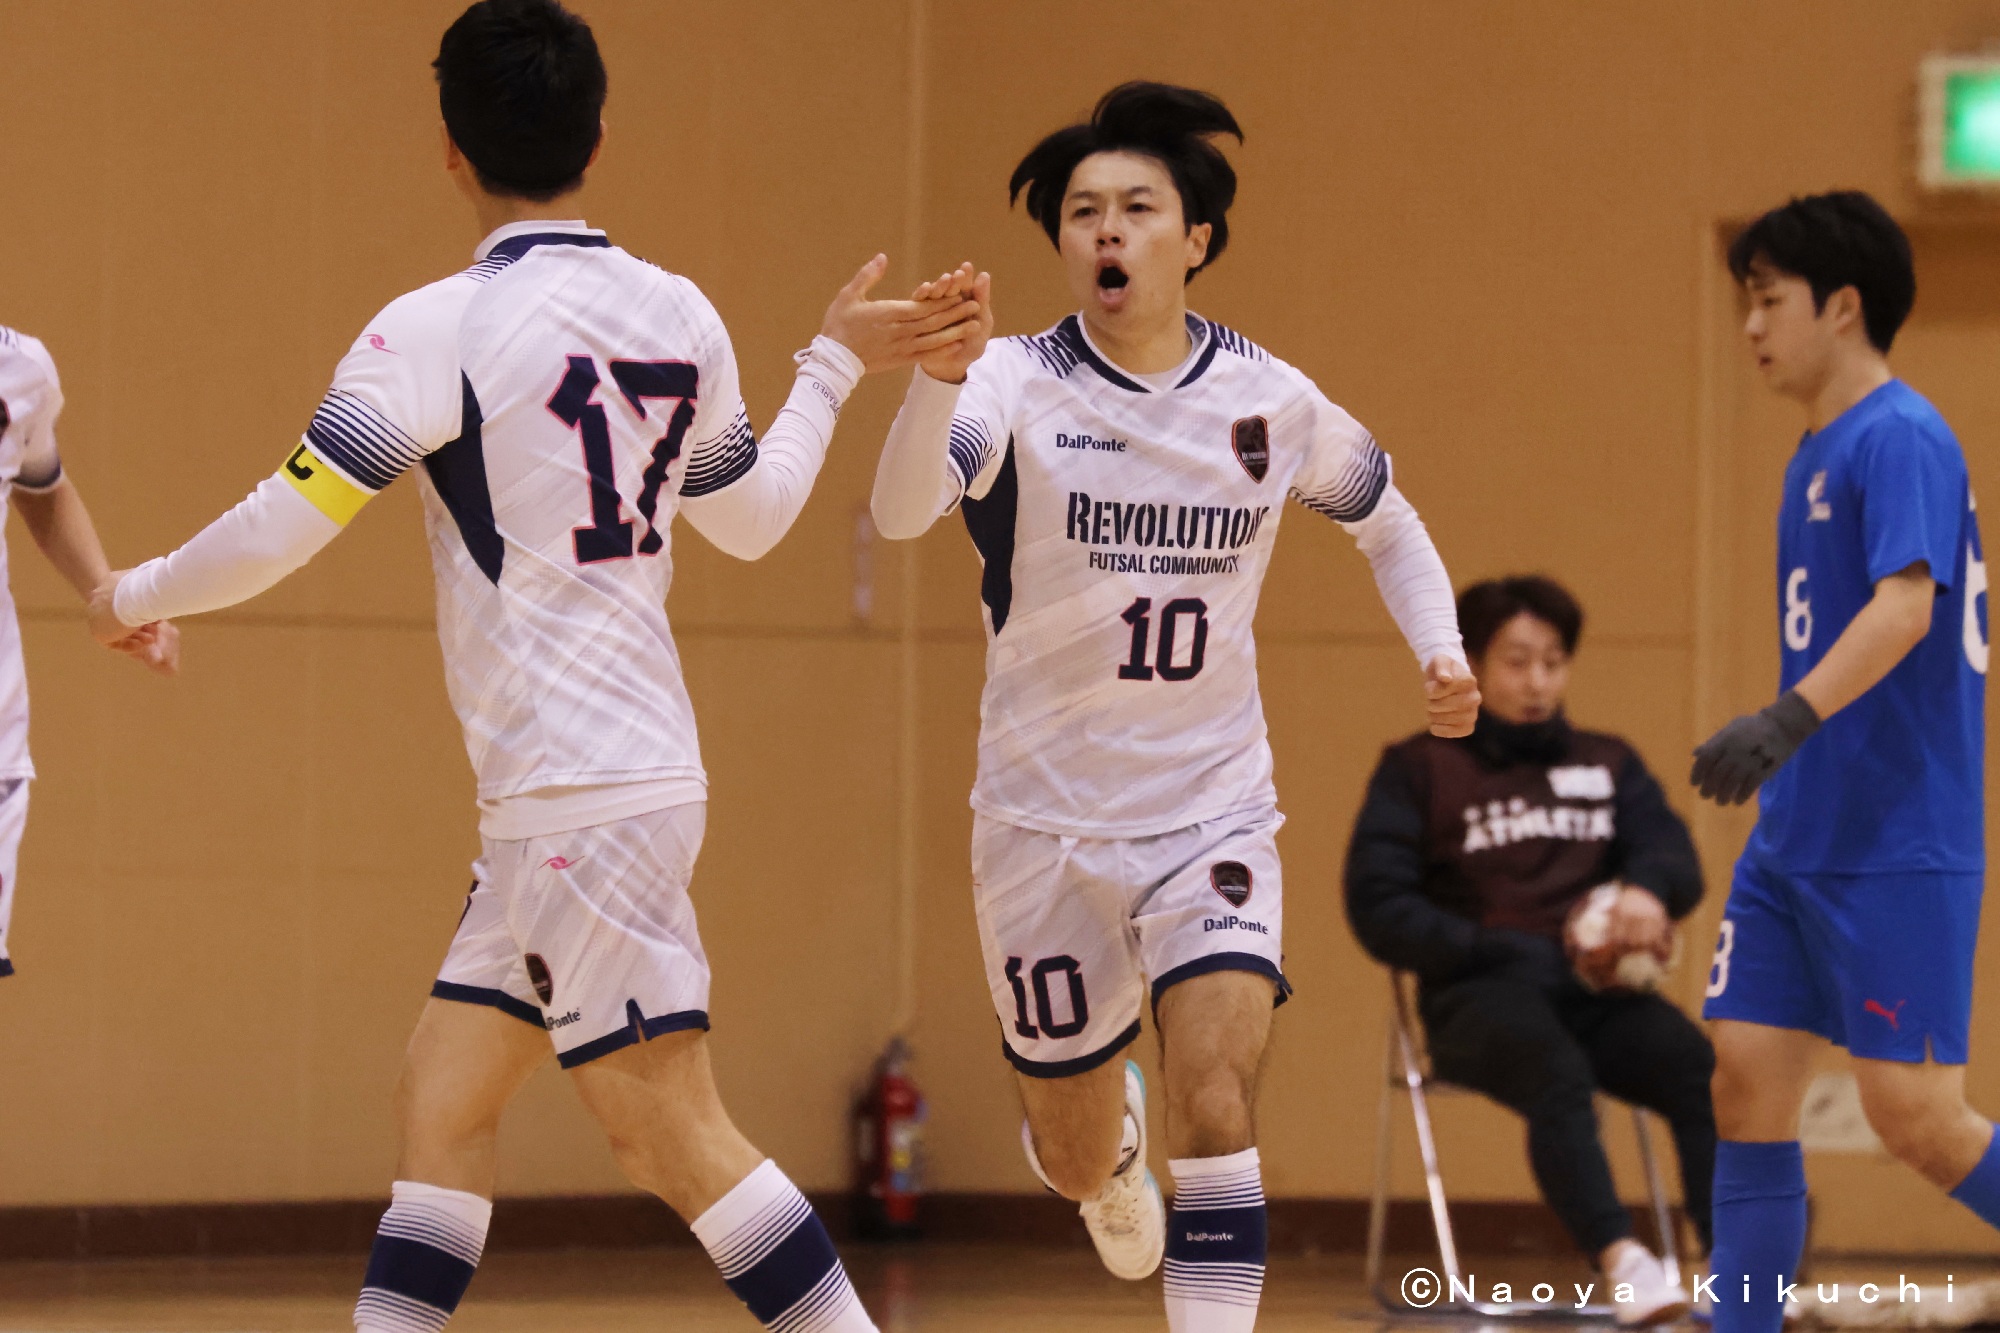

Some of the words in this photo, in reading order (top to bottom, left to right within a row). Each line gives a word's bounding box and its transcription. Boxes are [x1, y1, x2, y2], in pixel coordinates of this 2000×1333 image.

[546, 353, 699, 566] 17
[1056, 433, 1127, 453] DalPonte
[1066, 492, 1269, 549] REVOLUTION
[1089, 550, 1146, 573] FUTSAL
[1150, 554, 1240, 575] COMMUNITY
[1784, 567, 1812, 652] 8
[1117, 596, 1208, 681] 10
[1203, 915, 1269, 935] DalPonte
[1004, 954, 1089, 1040] 10
[545, 1010, 581, 1031] Ponte
[1186, 1232, 1234, 1242] DalPonte
